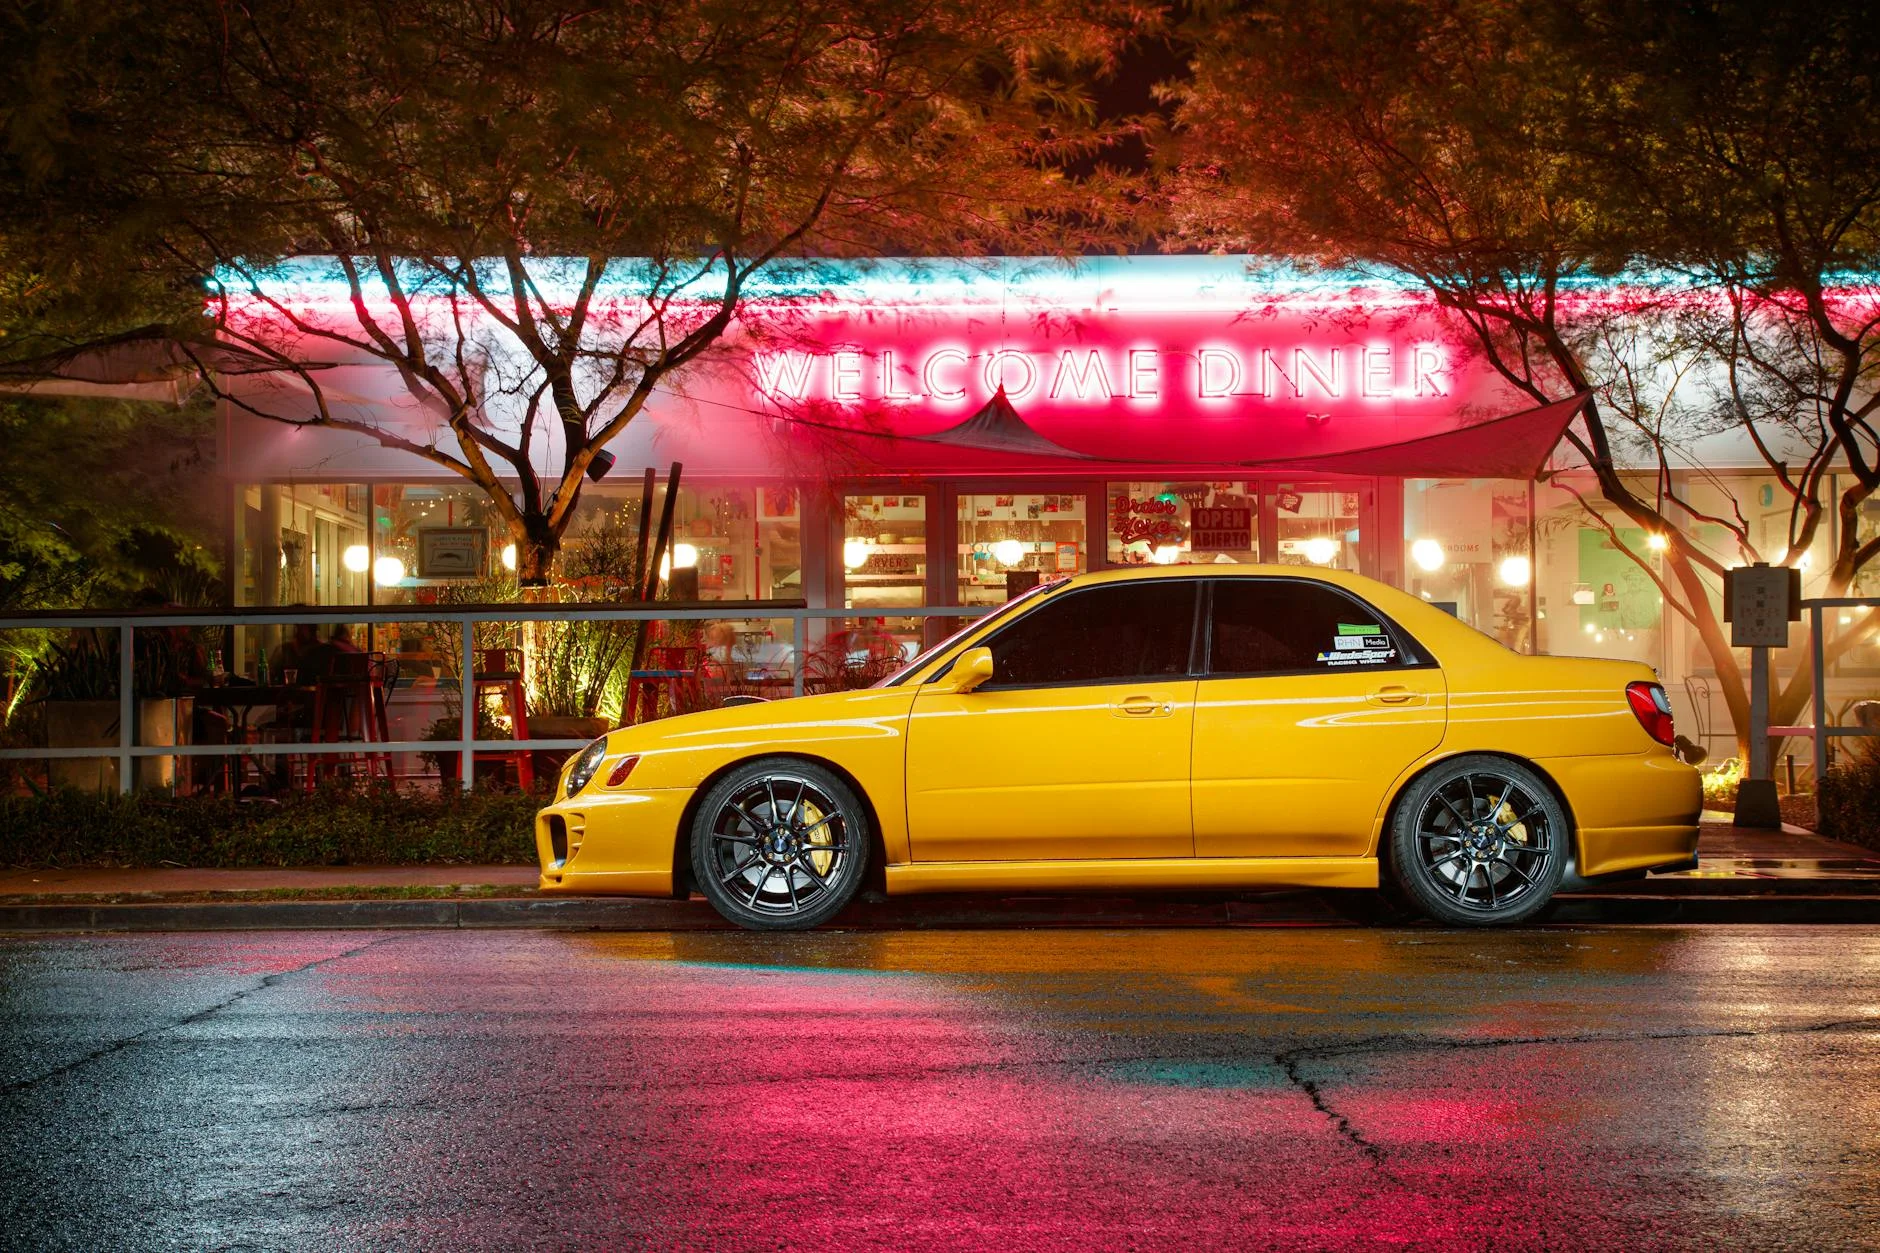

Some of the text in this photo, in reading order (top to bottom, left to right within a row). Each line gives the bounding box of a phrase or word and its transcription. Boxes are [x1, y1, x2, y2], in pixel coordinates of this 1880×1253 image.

[754, 347, 1449, 401] WELCOME DINER
[1115, 495, 1177, 515] Order
[1199, 510, 1245, 529] OPEN
[1193, 530, 1250, 548] ABIERTO
[1365, 638, 1386, 647] Media
